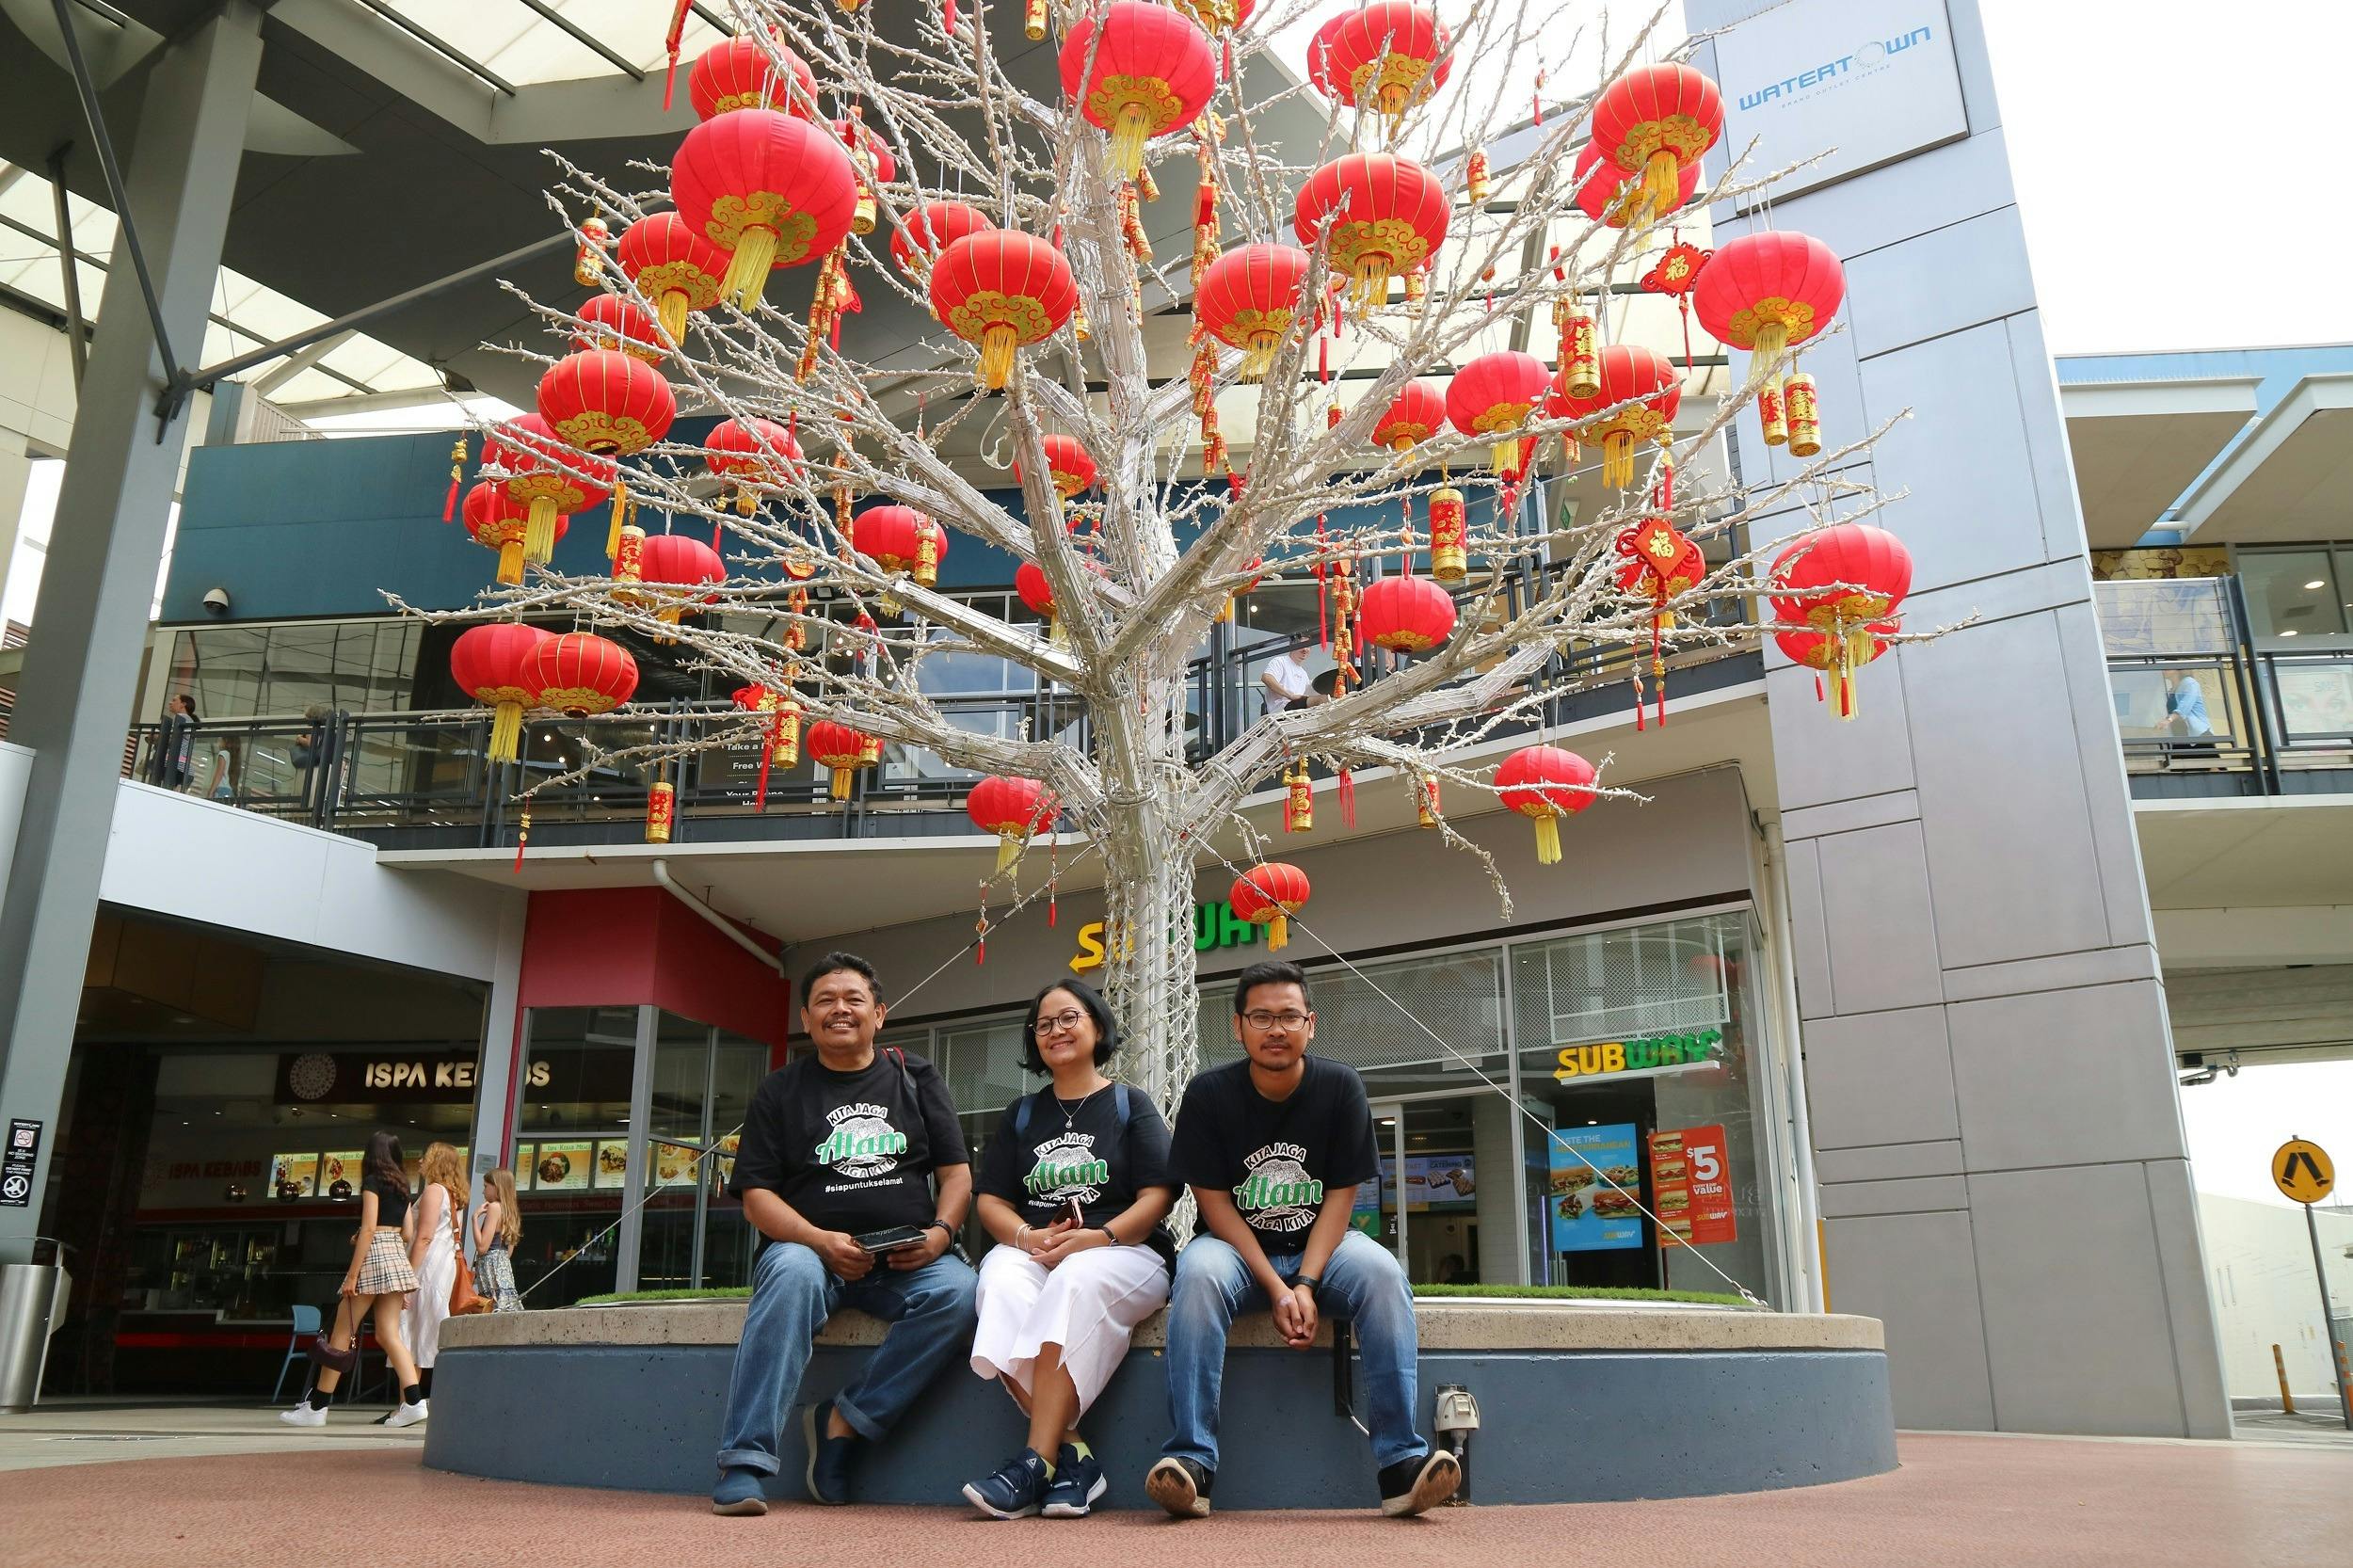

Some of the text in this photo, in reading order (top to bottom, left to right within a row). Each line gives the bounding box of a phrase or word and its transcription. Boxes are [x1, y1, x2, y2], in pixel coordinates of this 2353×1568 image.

[1739, 26, 1931, 111] WATERTOWN
[1648, 529, 1675, 558] 福
[727, 743, 750, 751] Take
[732, 761, 754, 770] Free
[1553, 1029, 1721, 1081] SUBWAY
[365, 1063, 427, 1088] ISPA
[826, 1103, 888, 1128] KITA JAGA
[815, 1131, 908, 1165] Alam
[1033, 1132, 1096, 1158] KITA JAGA
[1243, 1142, 1306, 1170] KITA JAGA
[832, 1157, 898, 1178] JAGA KITA
[1687, 1145, 1720, 1181] $5
[825, 1176, 904, 1192] #siapuntukselamat
[1023, 1159, 1110, 1195] Alam
[1694, 1183, 1723, 1195] value
[1233, 1174, 1323, 1210] Alam
[1245, 1208, 1317, 1232] JAGA KITA
[1696, 1211, 1728, 1221] SUBWAY
